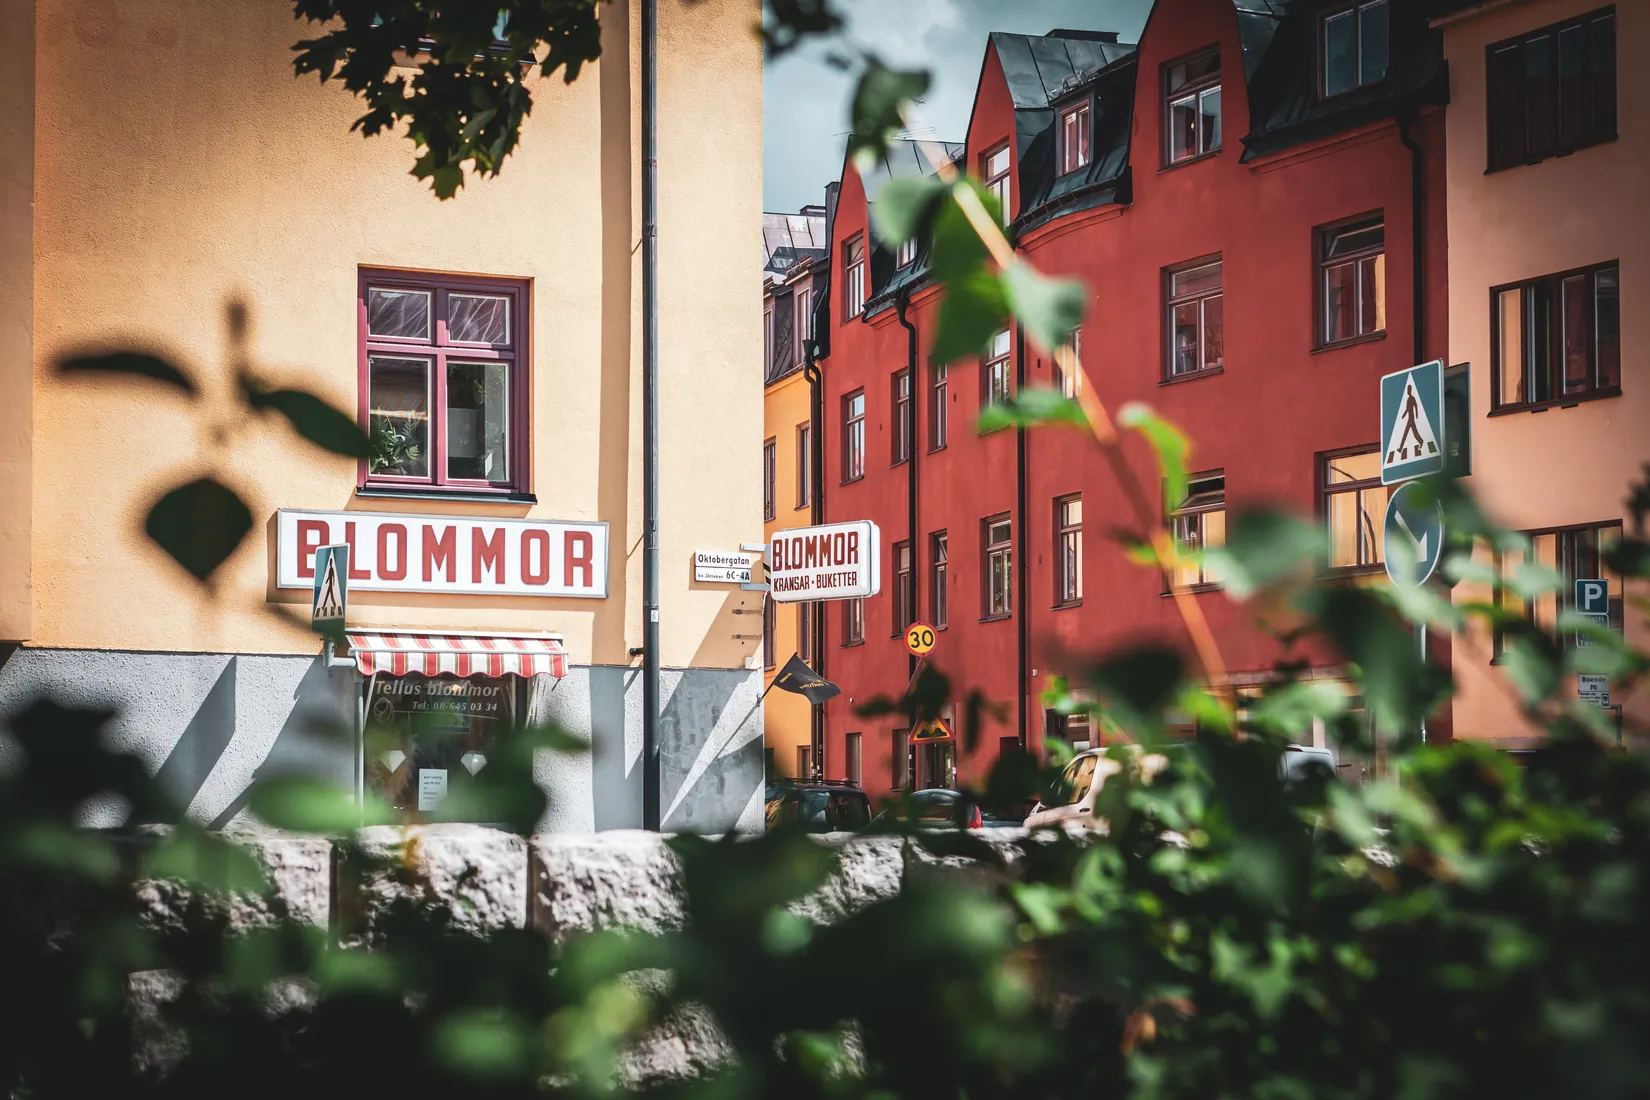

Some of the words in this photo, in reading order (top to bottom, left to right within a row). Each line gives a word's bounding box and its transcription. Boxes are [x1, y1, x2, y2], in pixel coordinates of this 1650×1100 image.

[297, 519, 593, 588] BLOMMOR
[698, 554, 750, 567] Oktobergatan
[772, 531, 859, 572] BLOMMOR
[726, 570, 750, 581] 6C-4A
[773, 576, 810, 593] KRANSAR
[816, 571, 857, 588] BUKETTER
[1584, 583, 1603, 610] P
[909, 629, 934, 649] 30
[375, 679, 421, 696] Tellus
[427, 680, 500, 697] blommor
[412, 701, 429, 710] Tel:
[470, 702, 482, 712] 03
[485, 703, 498, 712] 34
